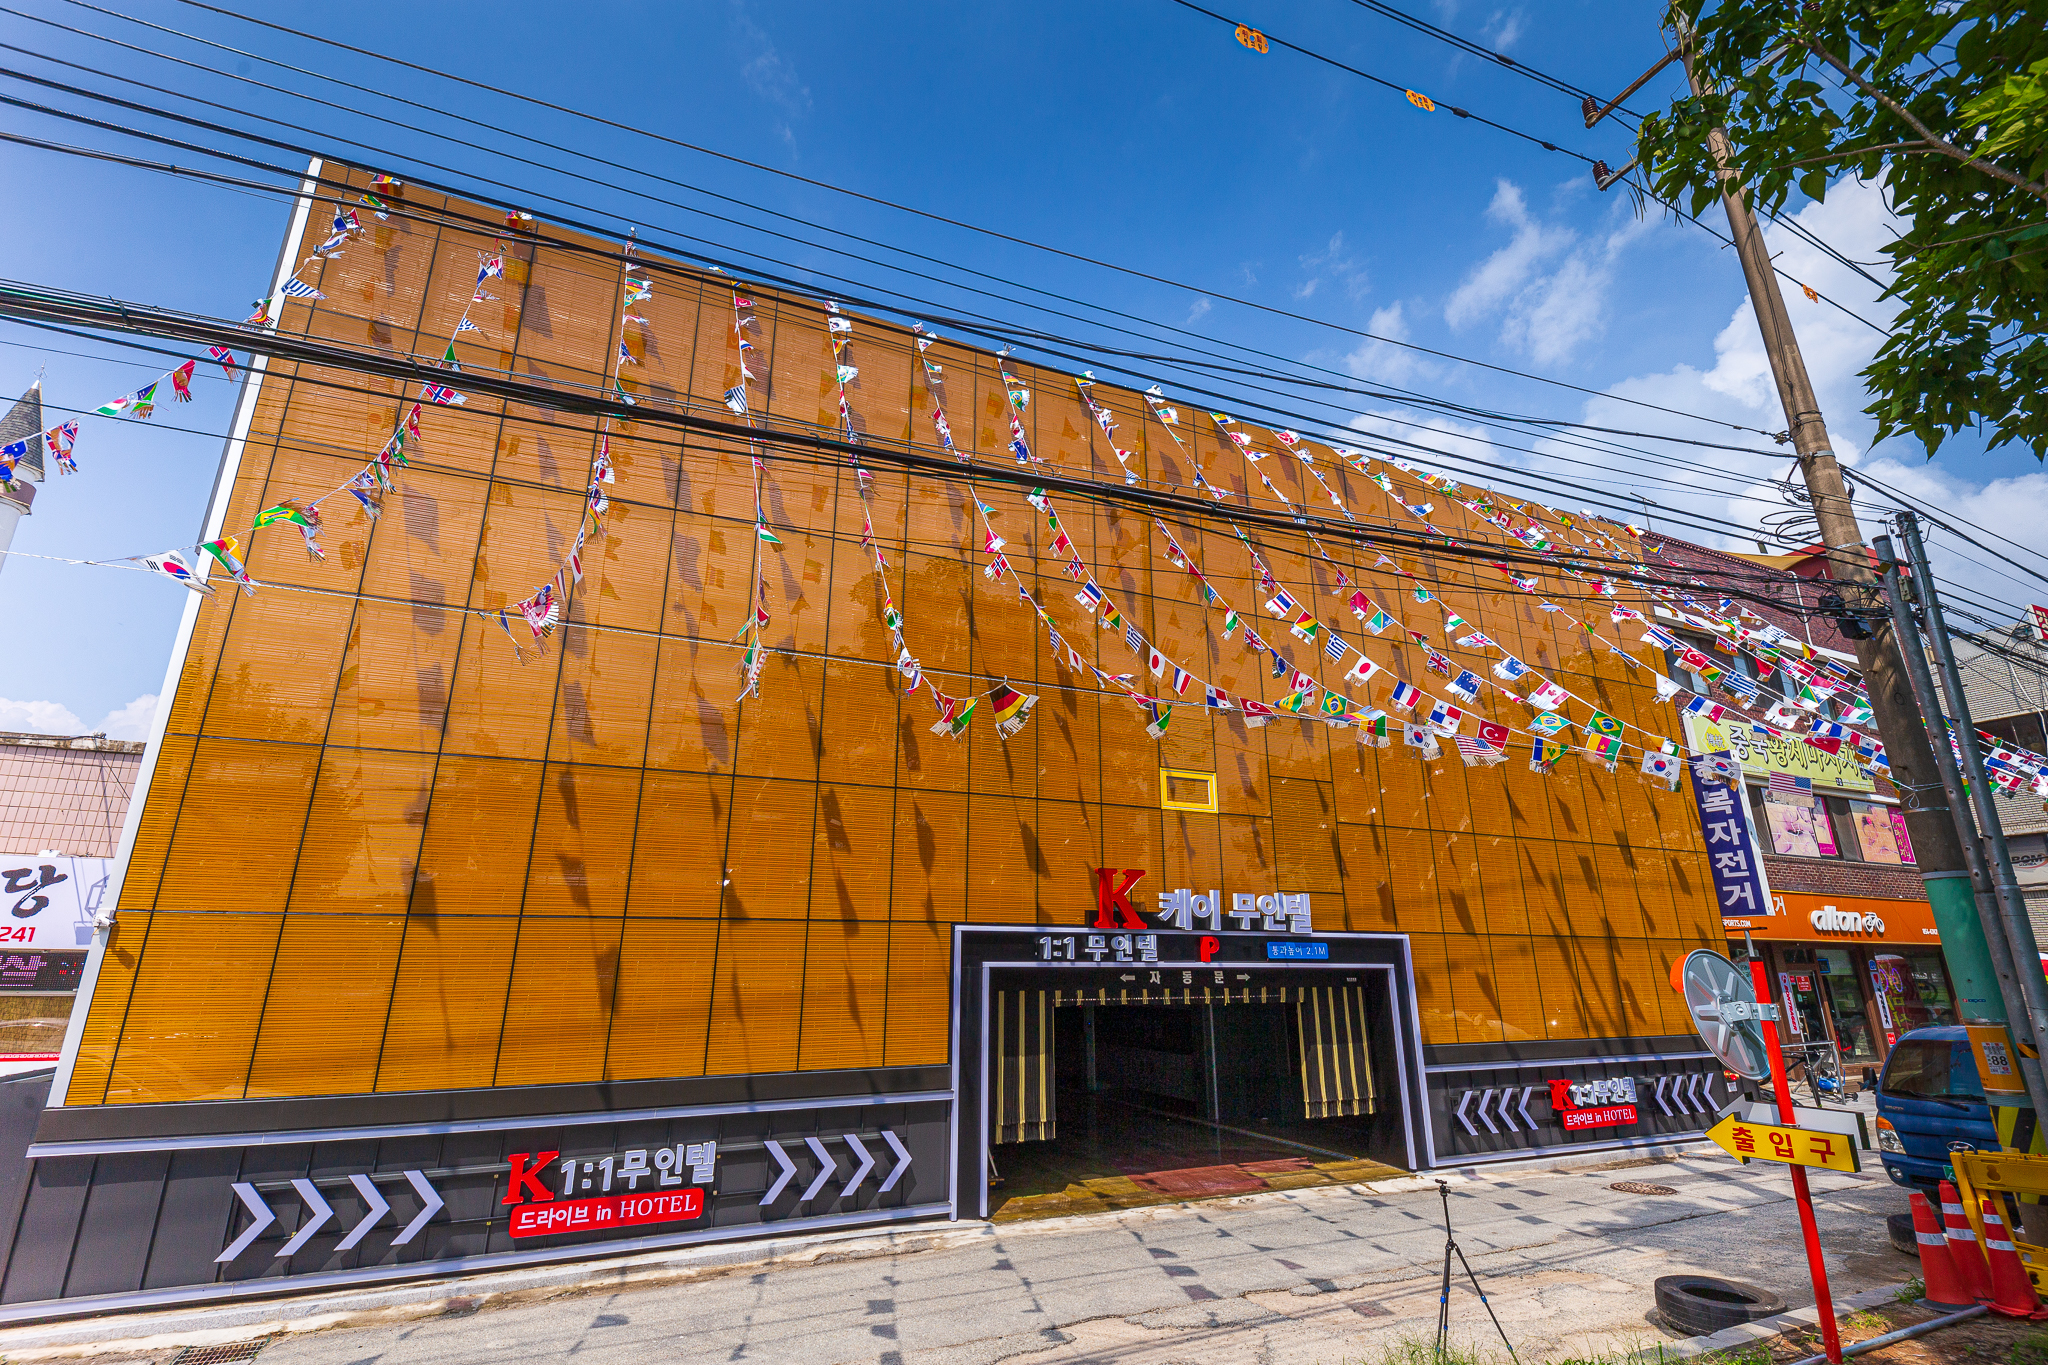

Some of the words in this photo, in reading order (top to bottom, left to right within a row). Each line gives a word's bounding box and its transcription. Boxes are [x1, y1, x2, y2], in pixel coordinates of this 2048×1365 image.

[1094, 867, 1148, 929] K
[1158, 888, 1221, 931] 케이
[1229, 892, 1313, 934] 무인텔
[1811, 905, 1863, 932] alton
[0, 926, 36, 943] 241
[1038, 935, 1075, 960] 1:1
[1085, 934, 1158, 962] 무인텔
[1200, 936, 1220, 962] P
[1306, 946, 1326, 956] 2.1M
[1991, 1055, 2008, 1066] 88
[1548, 1079, 1578, 1111] K
[1566, 1112, 1594, 1127] 드라이브
[1595, 1112, 1602, 1123] in
[1603, 1108, 1635, 1121] HOTEL
[1732, 1126, 1836, 1164] 출입구
[502, 1150, 560, 1205] K
[517, 1205, 590, 1231] 드라이브
[596, 1205, 612, 1222] in
[619, 1194, 698, 1219] HOTEL
